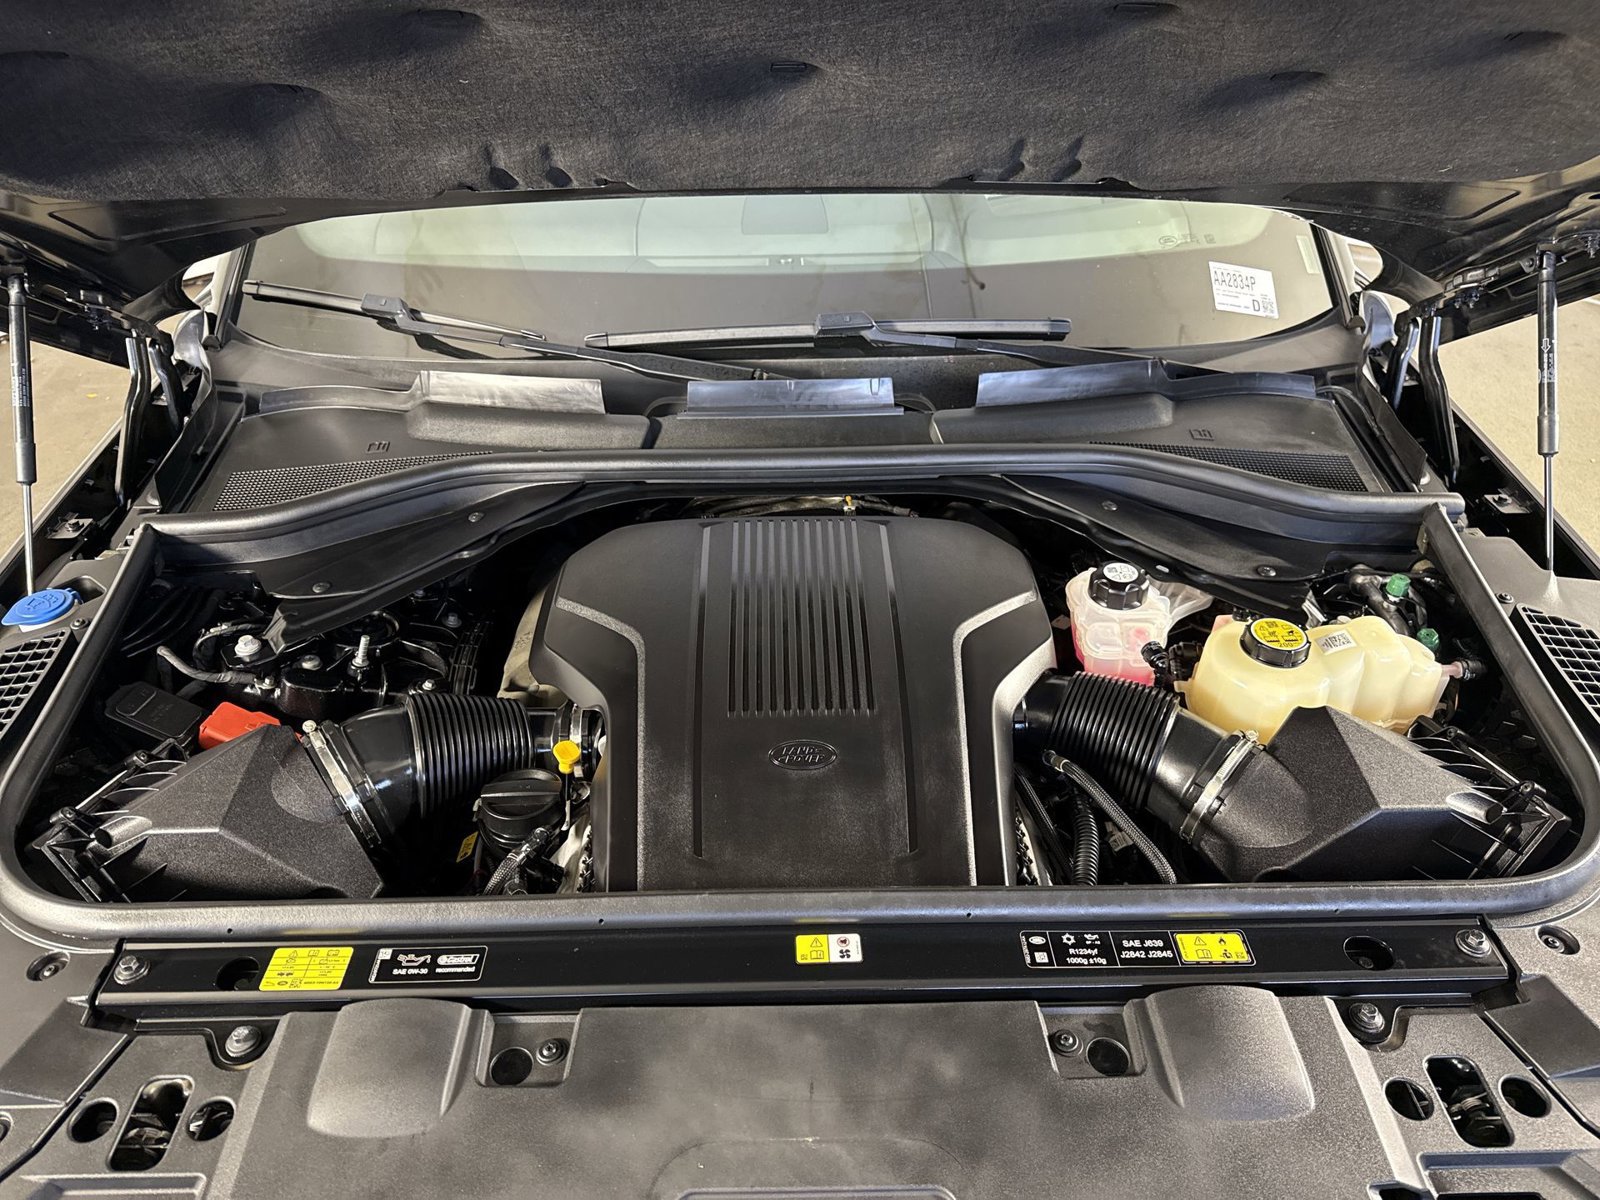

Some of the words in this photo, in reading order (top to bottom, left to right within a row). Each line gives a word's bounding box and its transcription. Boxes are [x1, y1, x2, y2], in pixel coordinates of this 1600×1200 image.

[1214, 270, 1256, 291] AA2834P
[1252, 299, 1261, 312] D
[1068, 948, 1098, 956] R1234yf
[1120, 950, 1146, 958] J2842
[1147, 950, 1173, 958] J2845
[1066, 957, 1088, 965] 1000g
